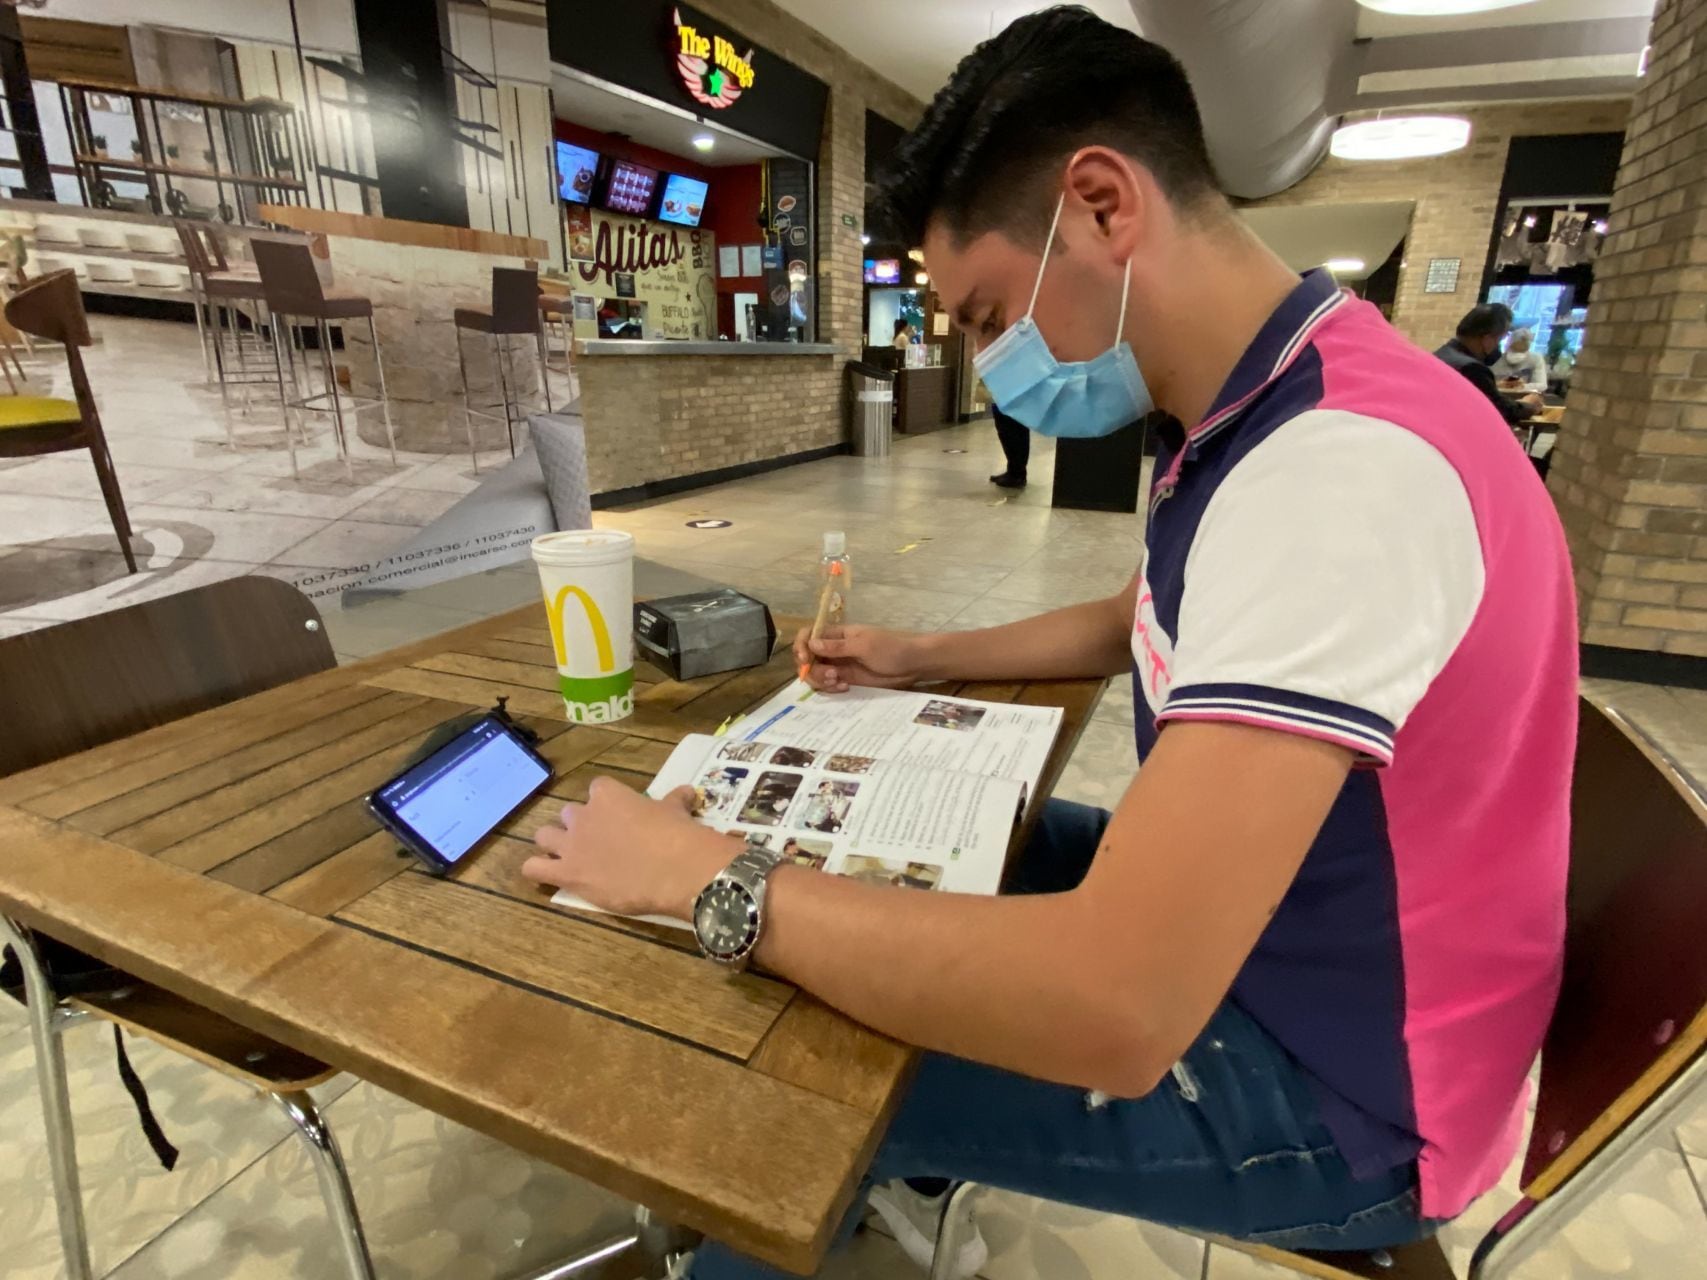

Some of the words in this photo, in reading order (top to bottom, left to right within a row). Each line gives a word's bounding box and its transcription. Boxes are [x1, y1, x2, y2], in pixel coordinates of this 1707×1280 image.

[678, 25, 711, 59] The
[713, 35, 755, 88] Wings
[578, 220, 685, 287] Alitas
